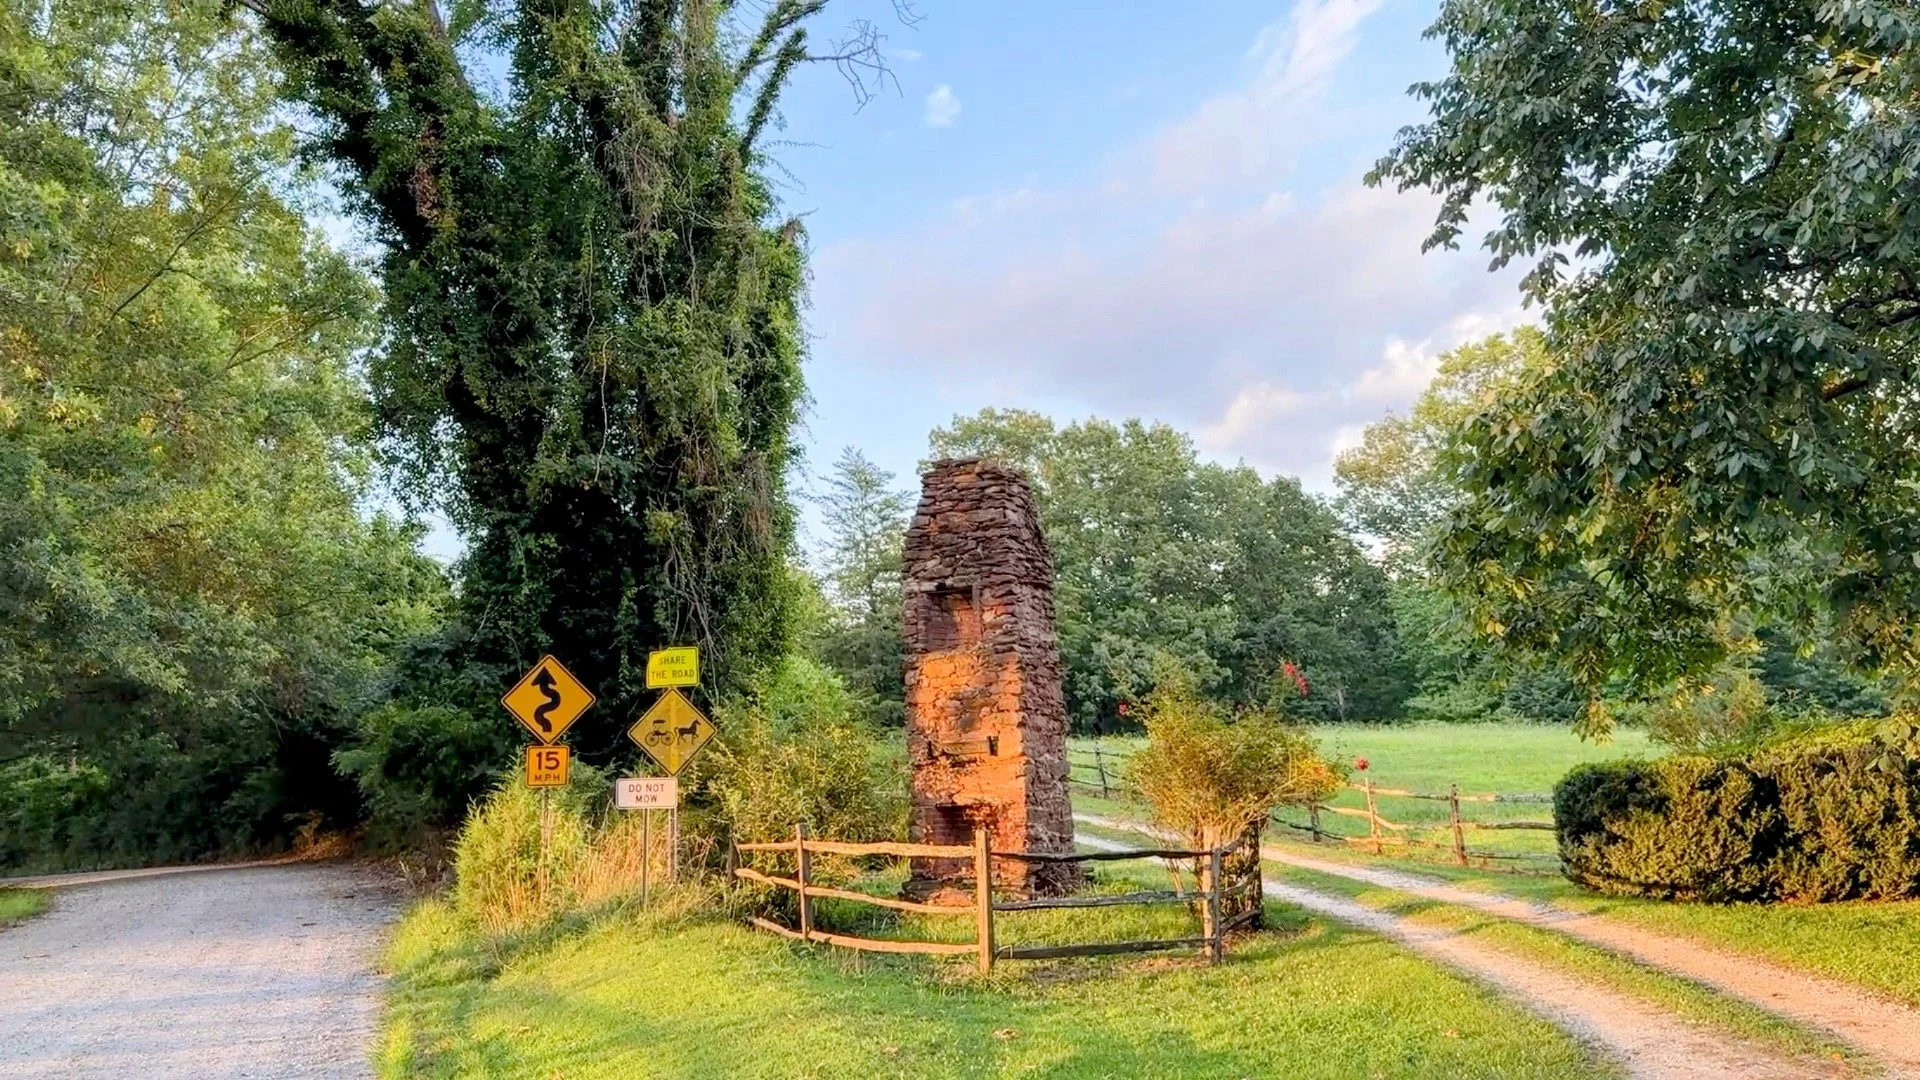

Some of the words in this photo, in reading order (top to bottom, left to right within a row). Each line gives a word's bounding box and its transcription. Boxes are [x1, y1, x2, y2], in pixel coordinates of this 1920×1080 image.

[658, 655, 687, 665] SHARE
[651, 670, 667, 680] THE
[671, 669, 695, 679] ROAD
[536, 751, 560, 770] 15
[628, 784, 642, 792] DO
[646, 783, 664, 792] NOT
[635, 794, 657, 803] MOW
